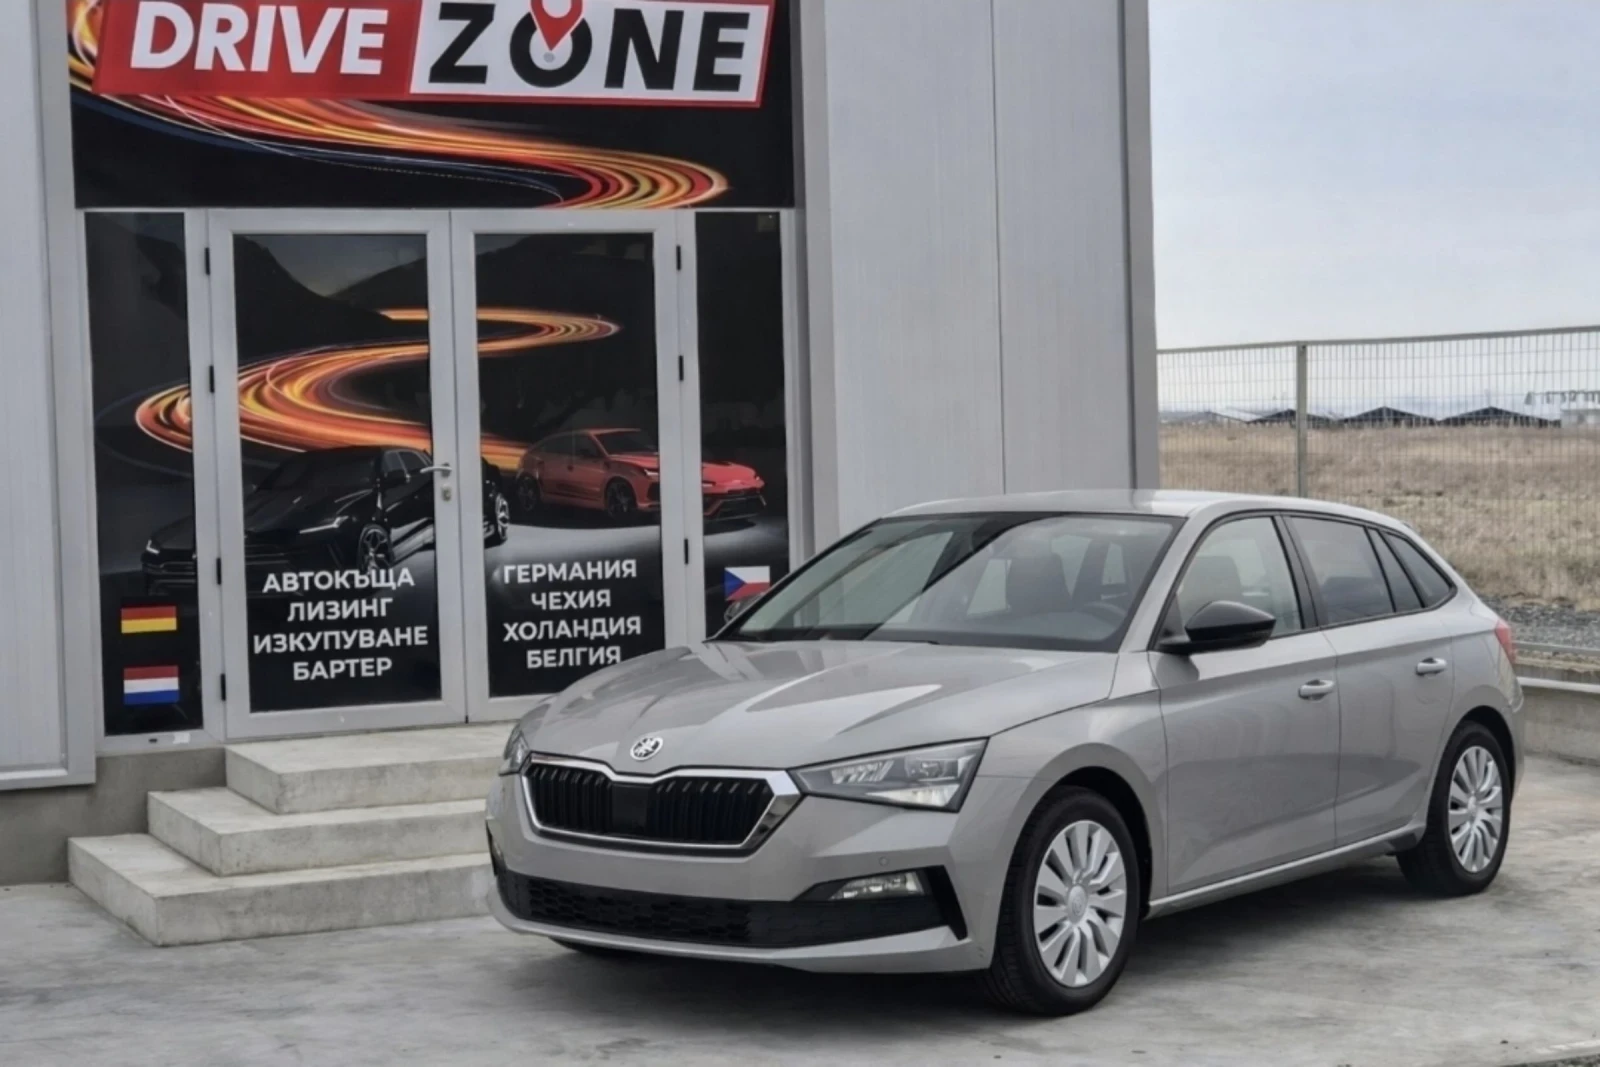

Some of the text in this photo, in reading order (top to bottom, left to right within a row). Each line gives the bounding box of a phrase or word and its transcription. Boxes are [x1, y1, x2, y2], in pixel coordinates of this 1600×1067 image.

[130, 0, 748, 91] DRIVE ZONE
[262, 568, 415, 593] АВТОКЪЩА
[503, 559, 637, 584] ГЕРМАНИЯ
[287, 598, 393, 622] ЛИЗИНГ
[531, 589, 611, 610] ЧЕХИЯ
[253, 626, 428, 654] ИЗКУПУВАНЕ
[503, 616, 642, 641] ХОЛАНДИЯ
[293, 657, 392, 681] БАРТЕР
[526, 646, 621, 669] БЕЛГИЯ
